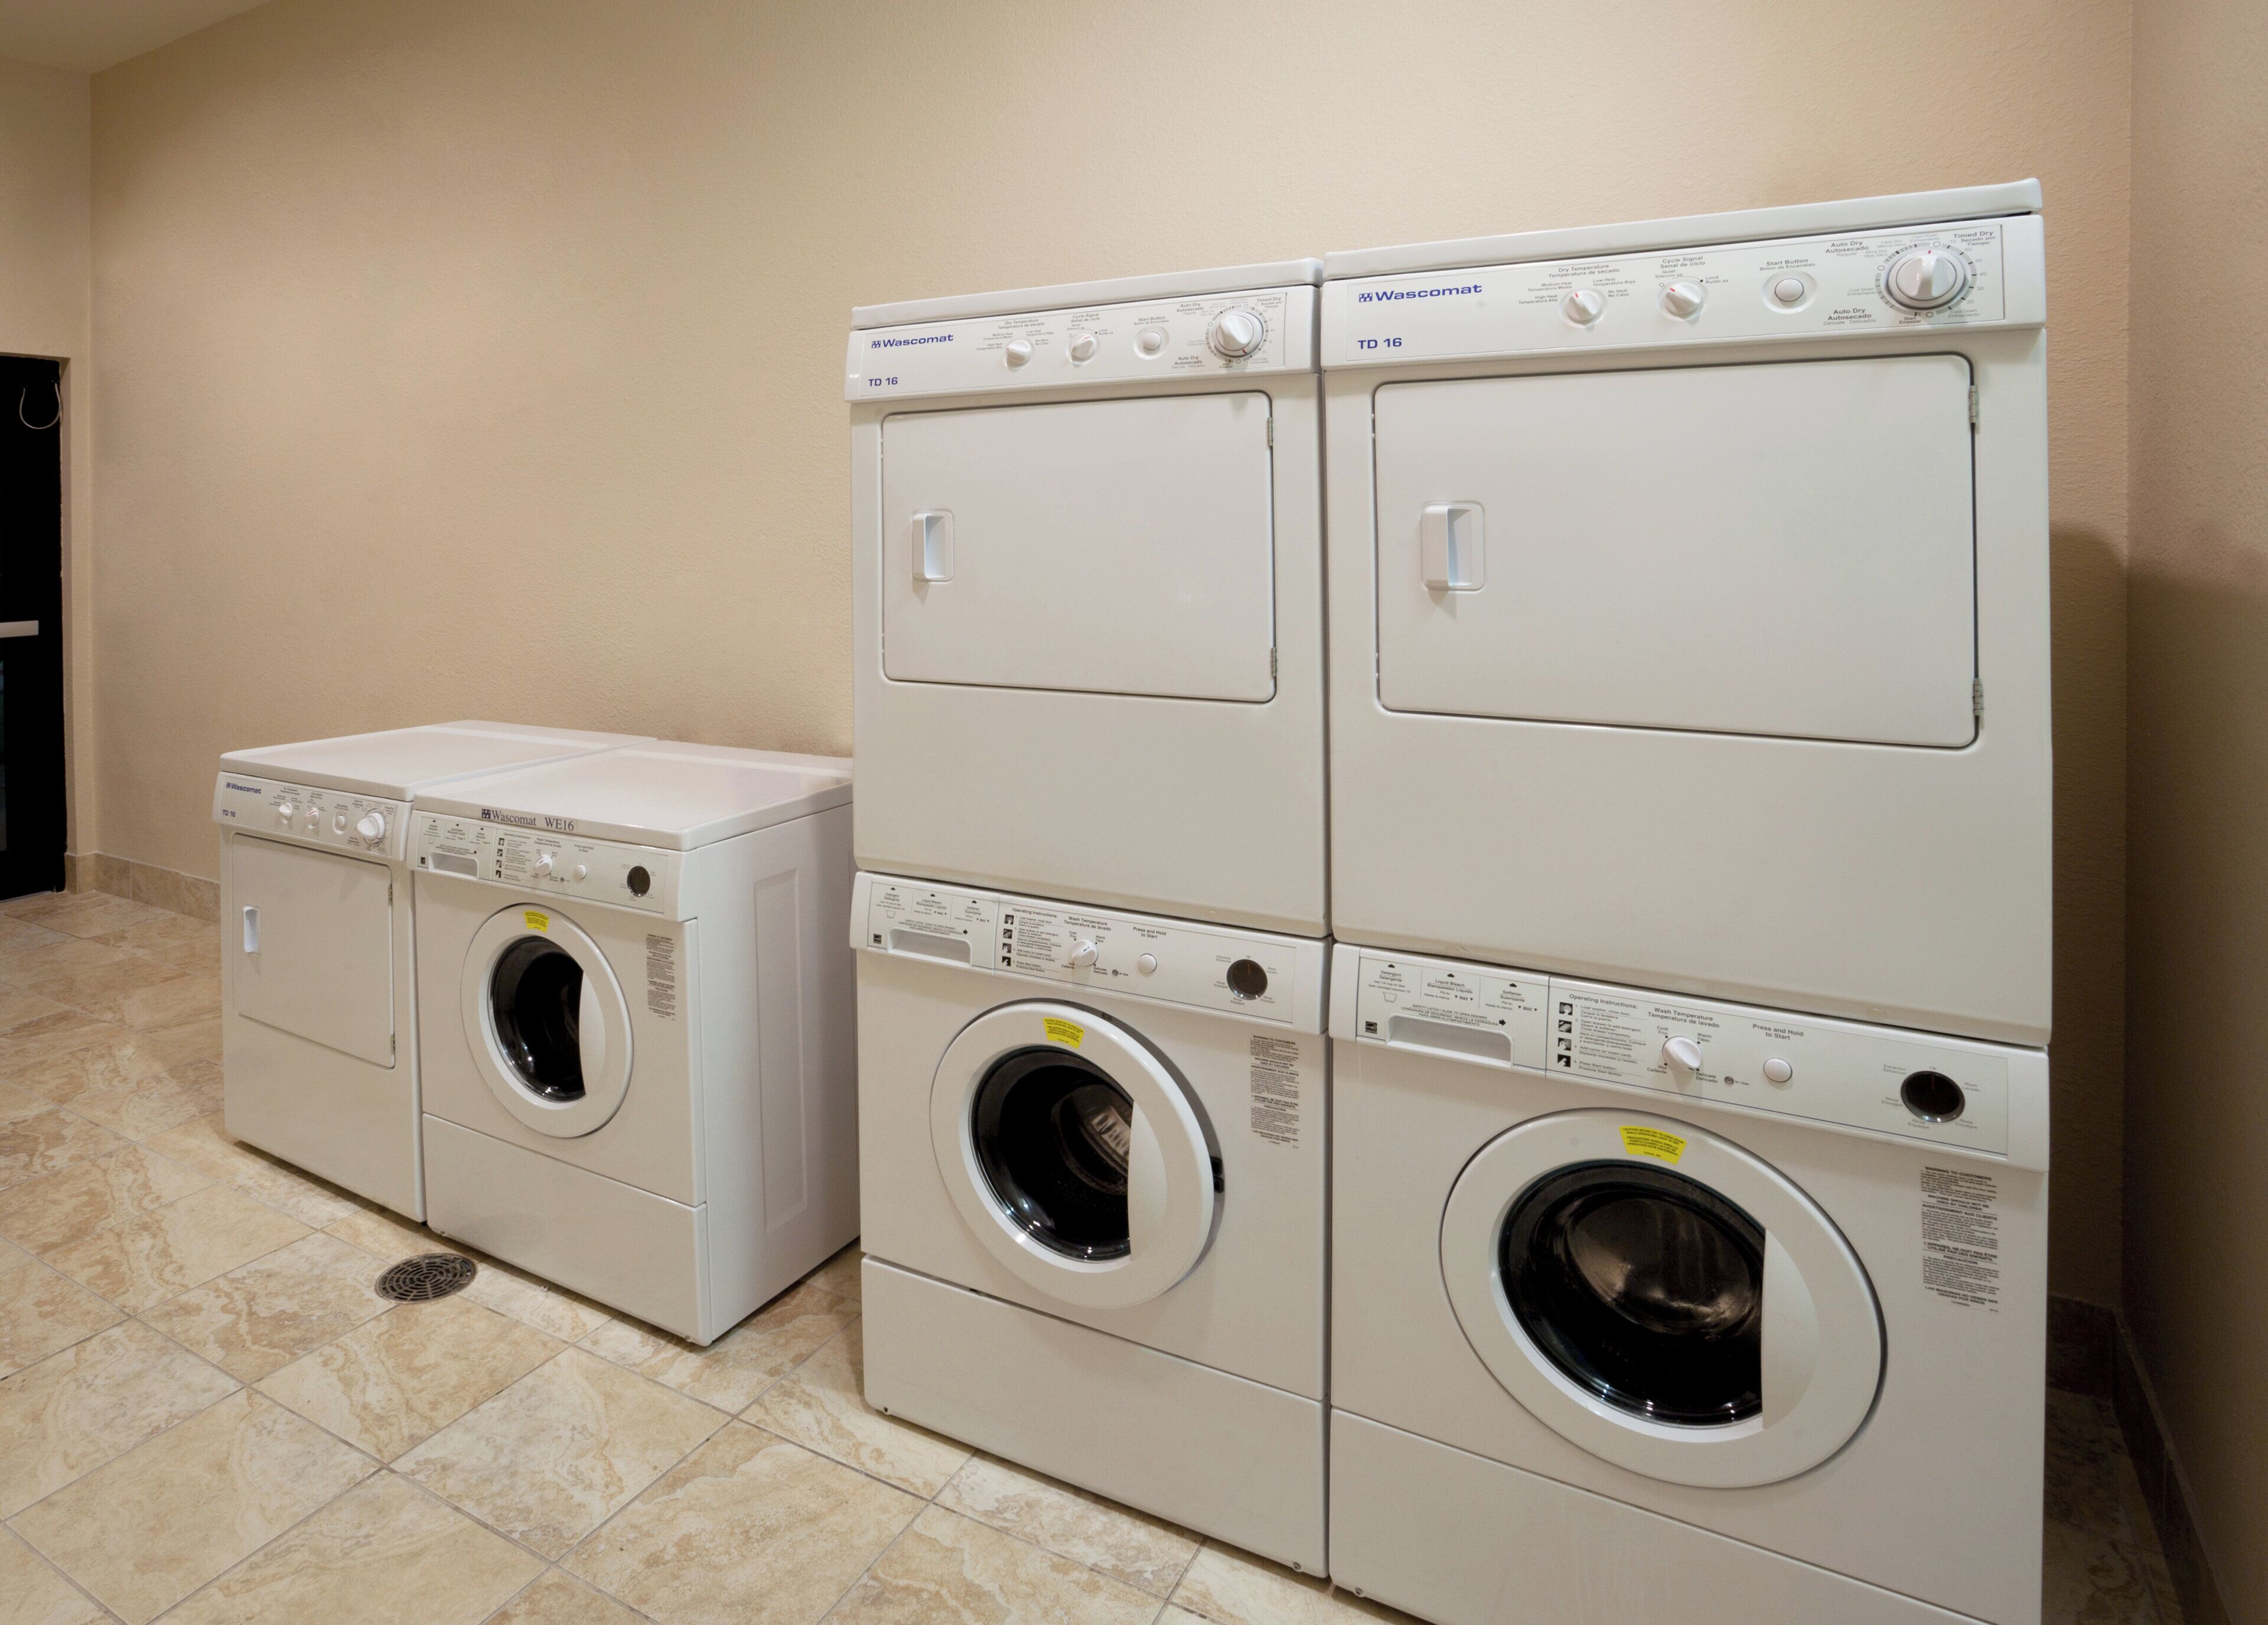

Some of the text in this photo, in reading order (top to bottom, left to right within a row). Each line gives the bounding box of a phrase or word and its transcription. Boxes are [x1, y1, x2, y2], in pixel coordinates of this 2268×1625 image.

[1376, 285, 1482, 301] Wascomat
[883, 334, 953, 347] Wascomat
[1358, 338, 1402, 349] TD 16
[231, 783, 261, 794] Wascomat
[492, 810, 574, 831] Wascomat WE16
[1569, 994, 1638, 1009] Operating Instructions:
[1648, 1012, 1687, 1022] Temperatura
[1673, 1010, 1713, 1021] Temperature
[1959, 1172, 1992, 1181] CUSTOMERS
